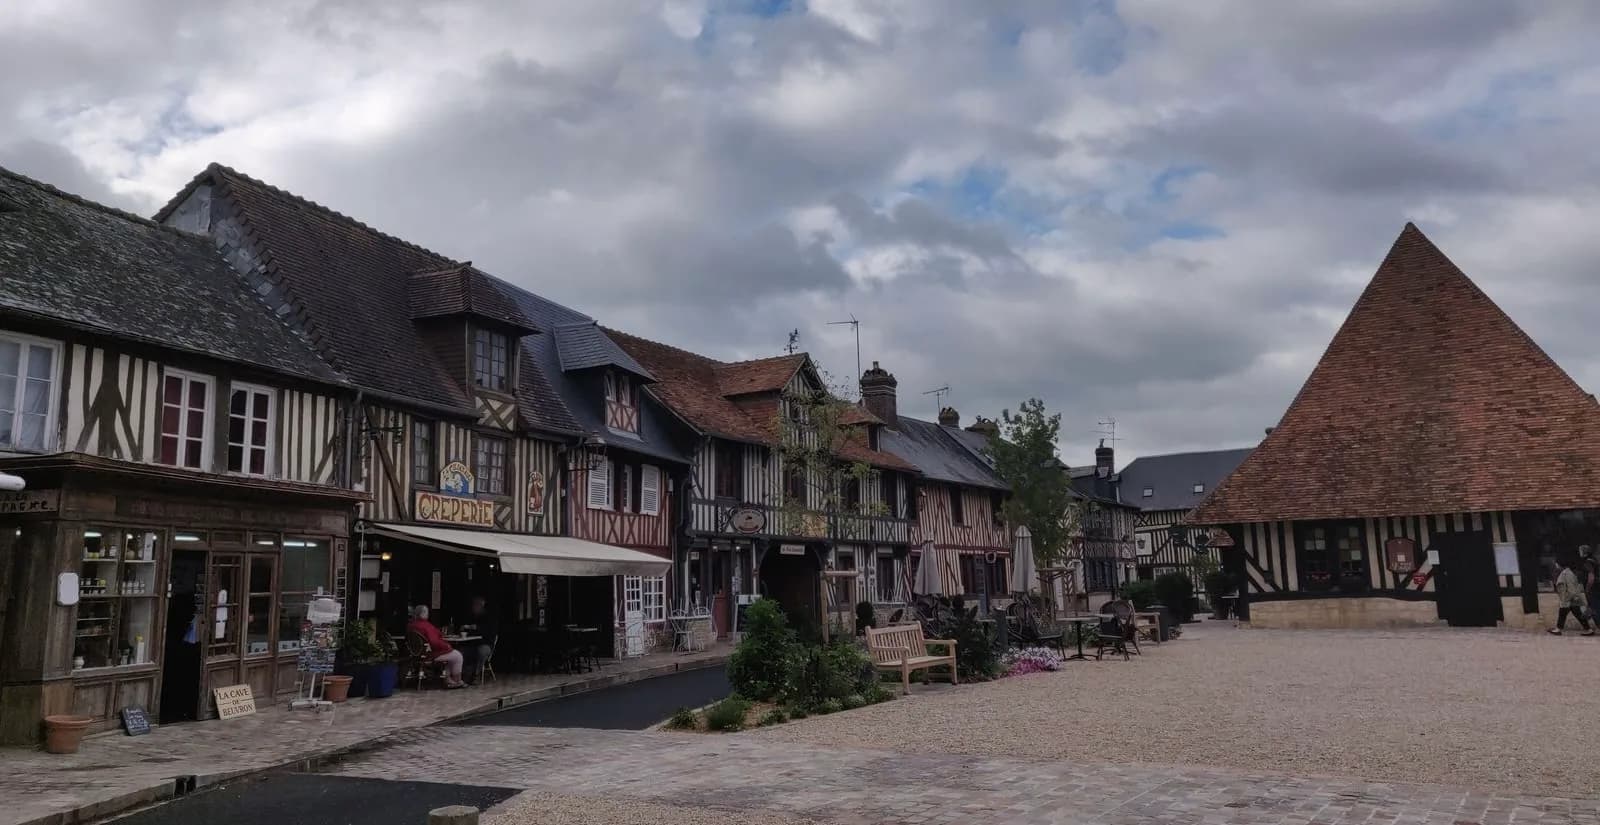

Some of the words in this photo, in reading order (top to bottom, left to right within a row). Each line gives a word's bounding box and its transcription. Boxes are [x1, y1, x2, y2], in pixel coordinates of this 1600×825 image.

[218, 691, 230, 700] LA
[230, 688, 249, 698] CAVE
[222, 704, 253, 716] BEUVRON
